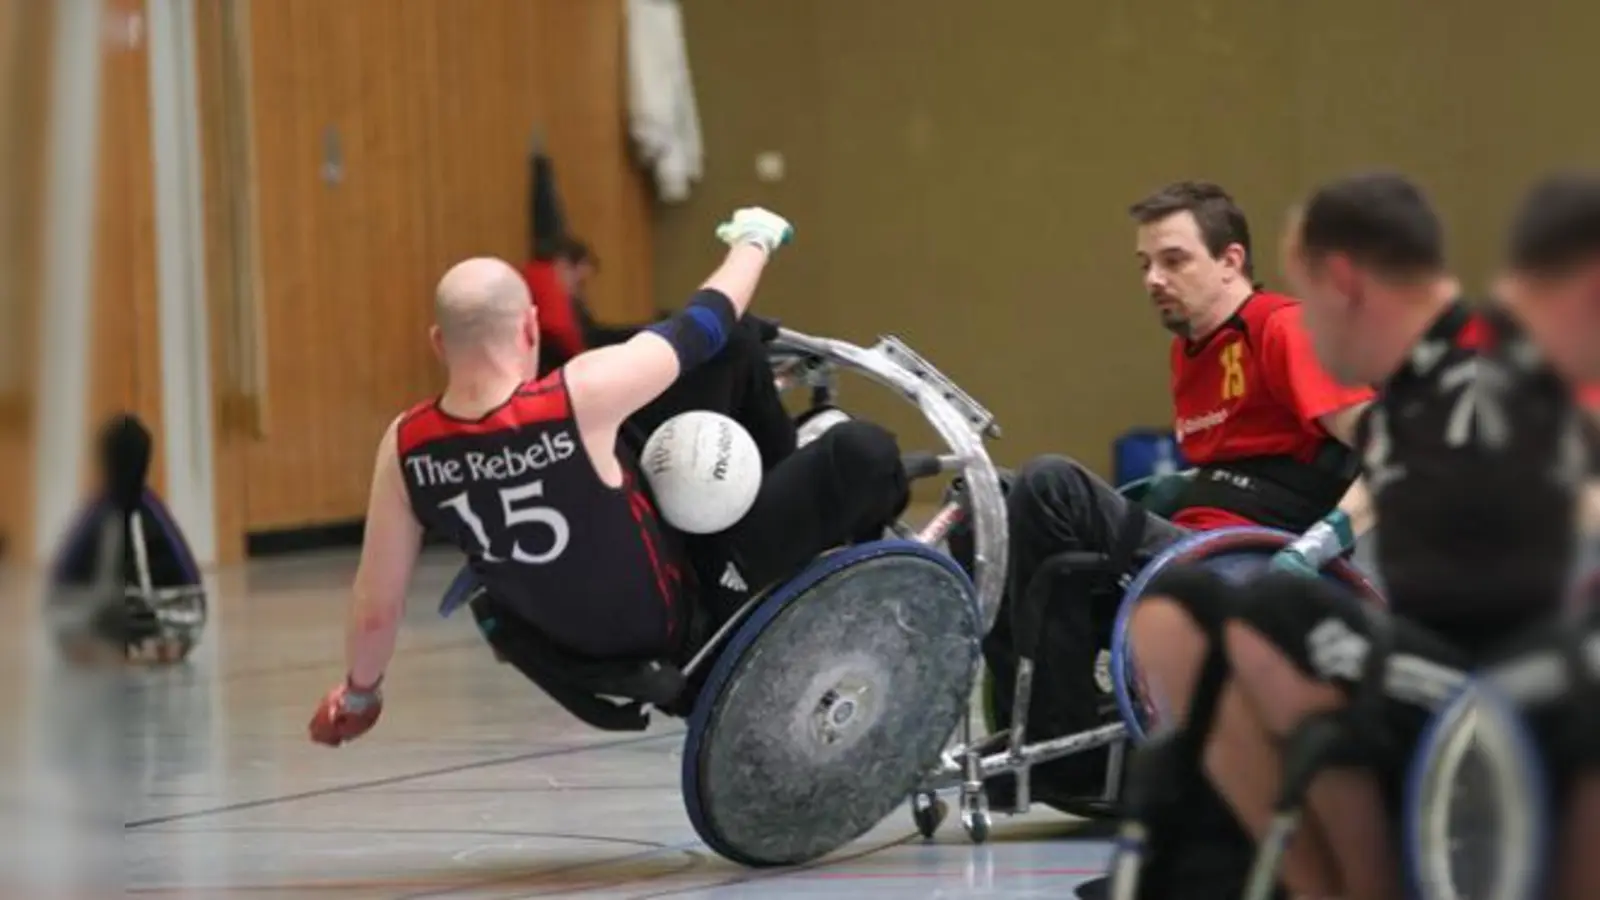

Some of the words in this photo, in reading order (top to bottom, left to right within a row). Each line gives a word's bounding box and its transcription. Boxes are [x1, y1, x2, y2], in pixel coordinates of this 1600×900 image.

[406, 453, 464, 487] The
[467, 429, 576, 481] Rebels
[437, 480, 571, 564] 15
